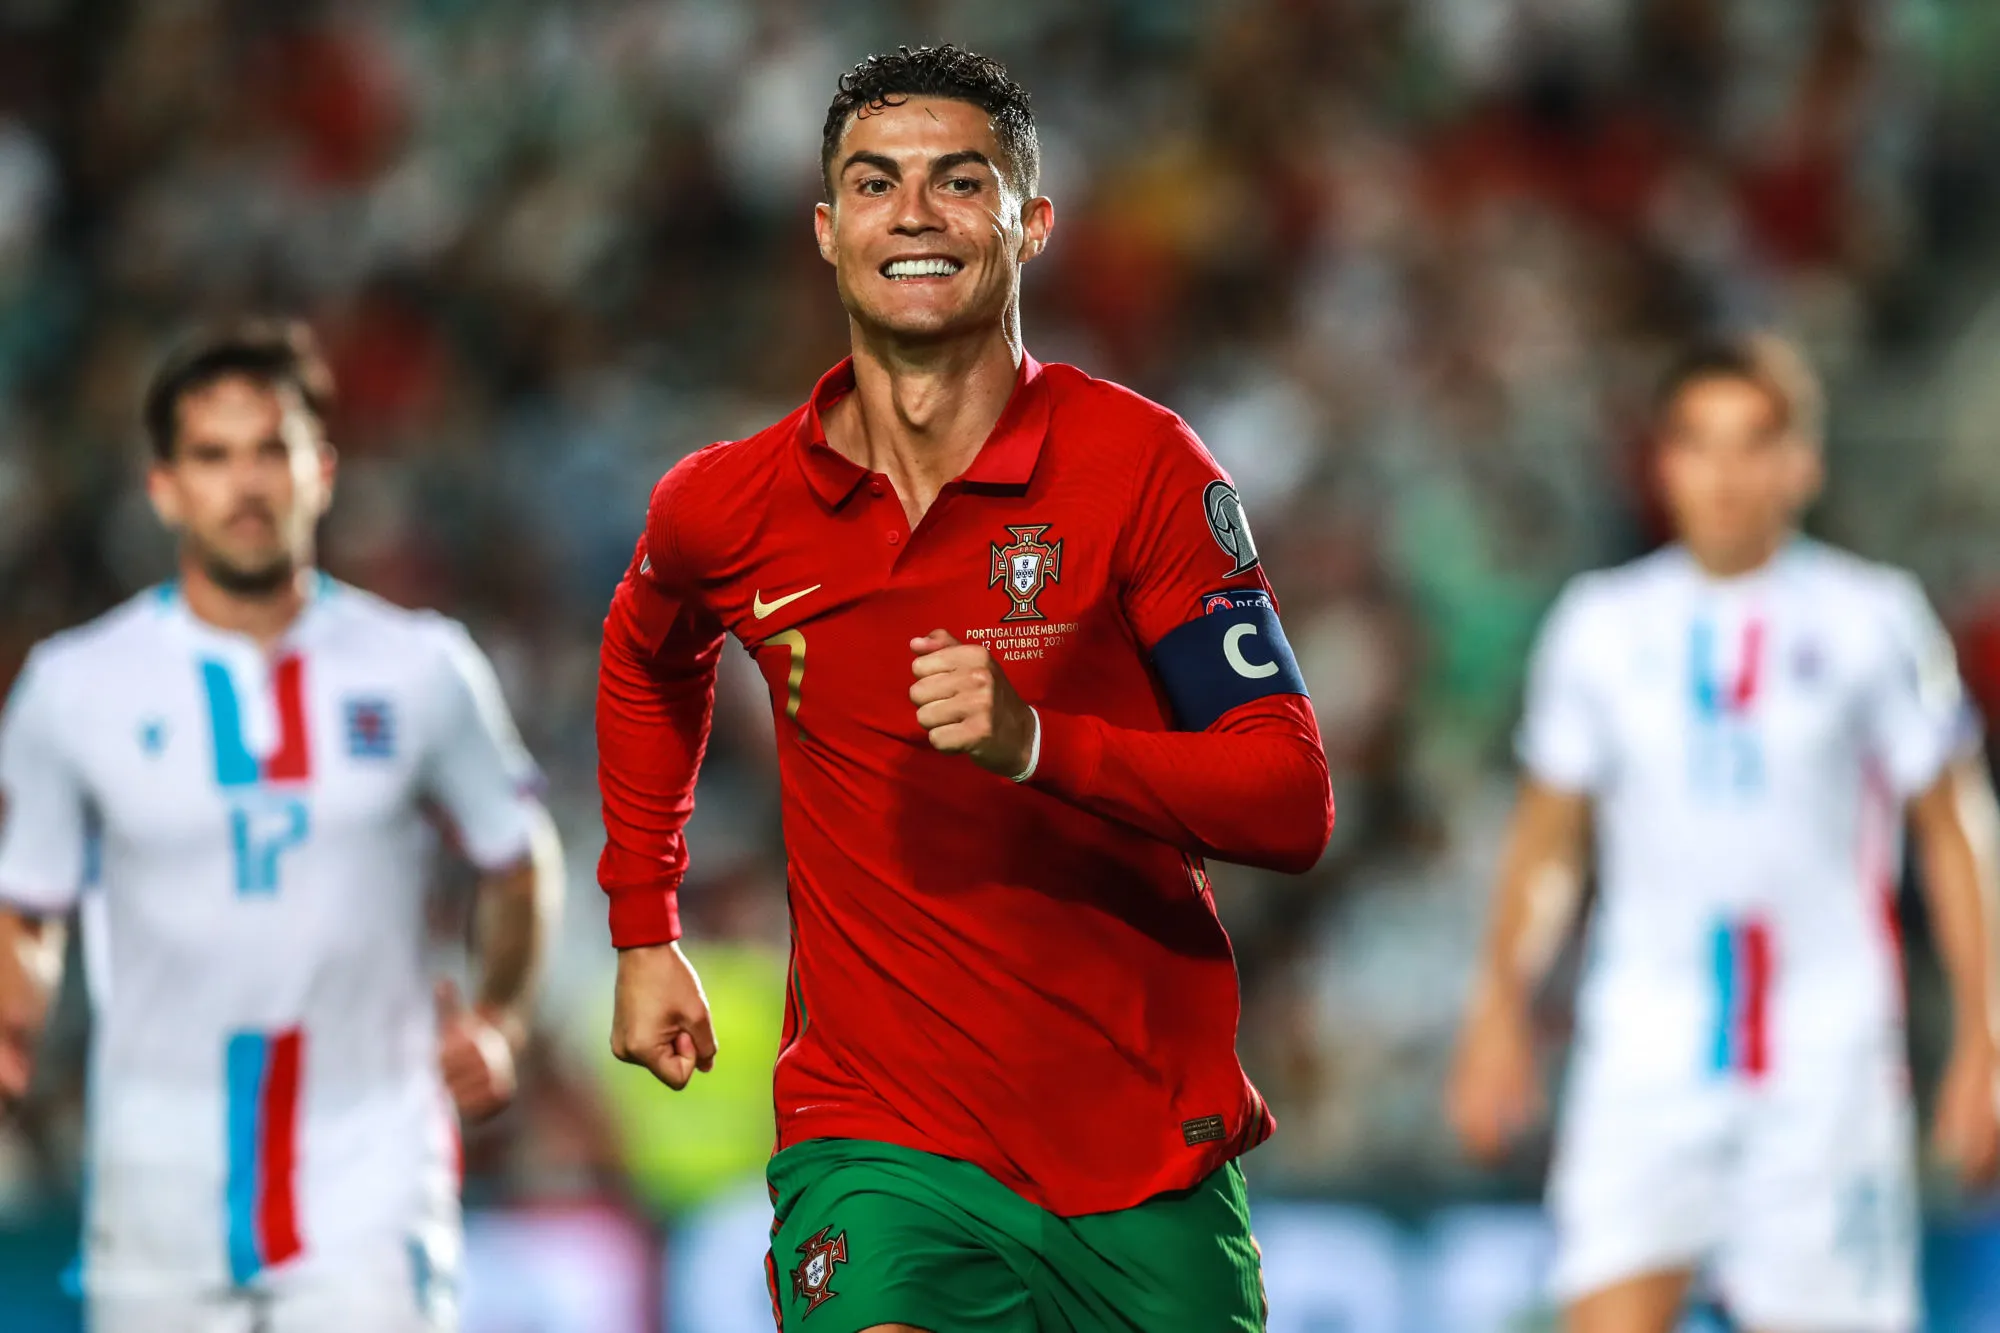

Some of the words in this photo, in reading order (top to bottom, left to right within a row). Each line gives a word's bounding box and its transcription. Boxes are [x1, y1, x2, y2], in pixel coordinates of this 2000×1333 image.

[966, 622, 1079, 639] PORTUGAL/LUXEMBURGO
[996, 638, 1040, 650] OUTUBRO
[1223, 622, 1280, 679] C
[1003, 649, 1044, 661] ALGARVE
[763, 629, 808, 742] 7
